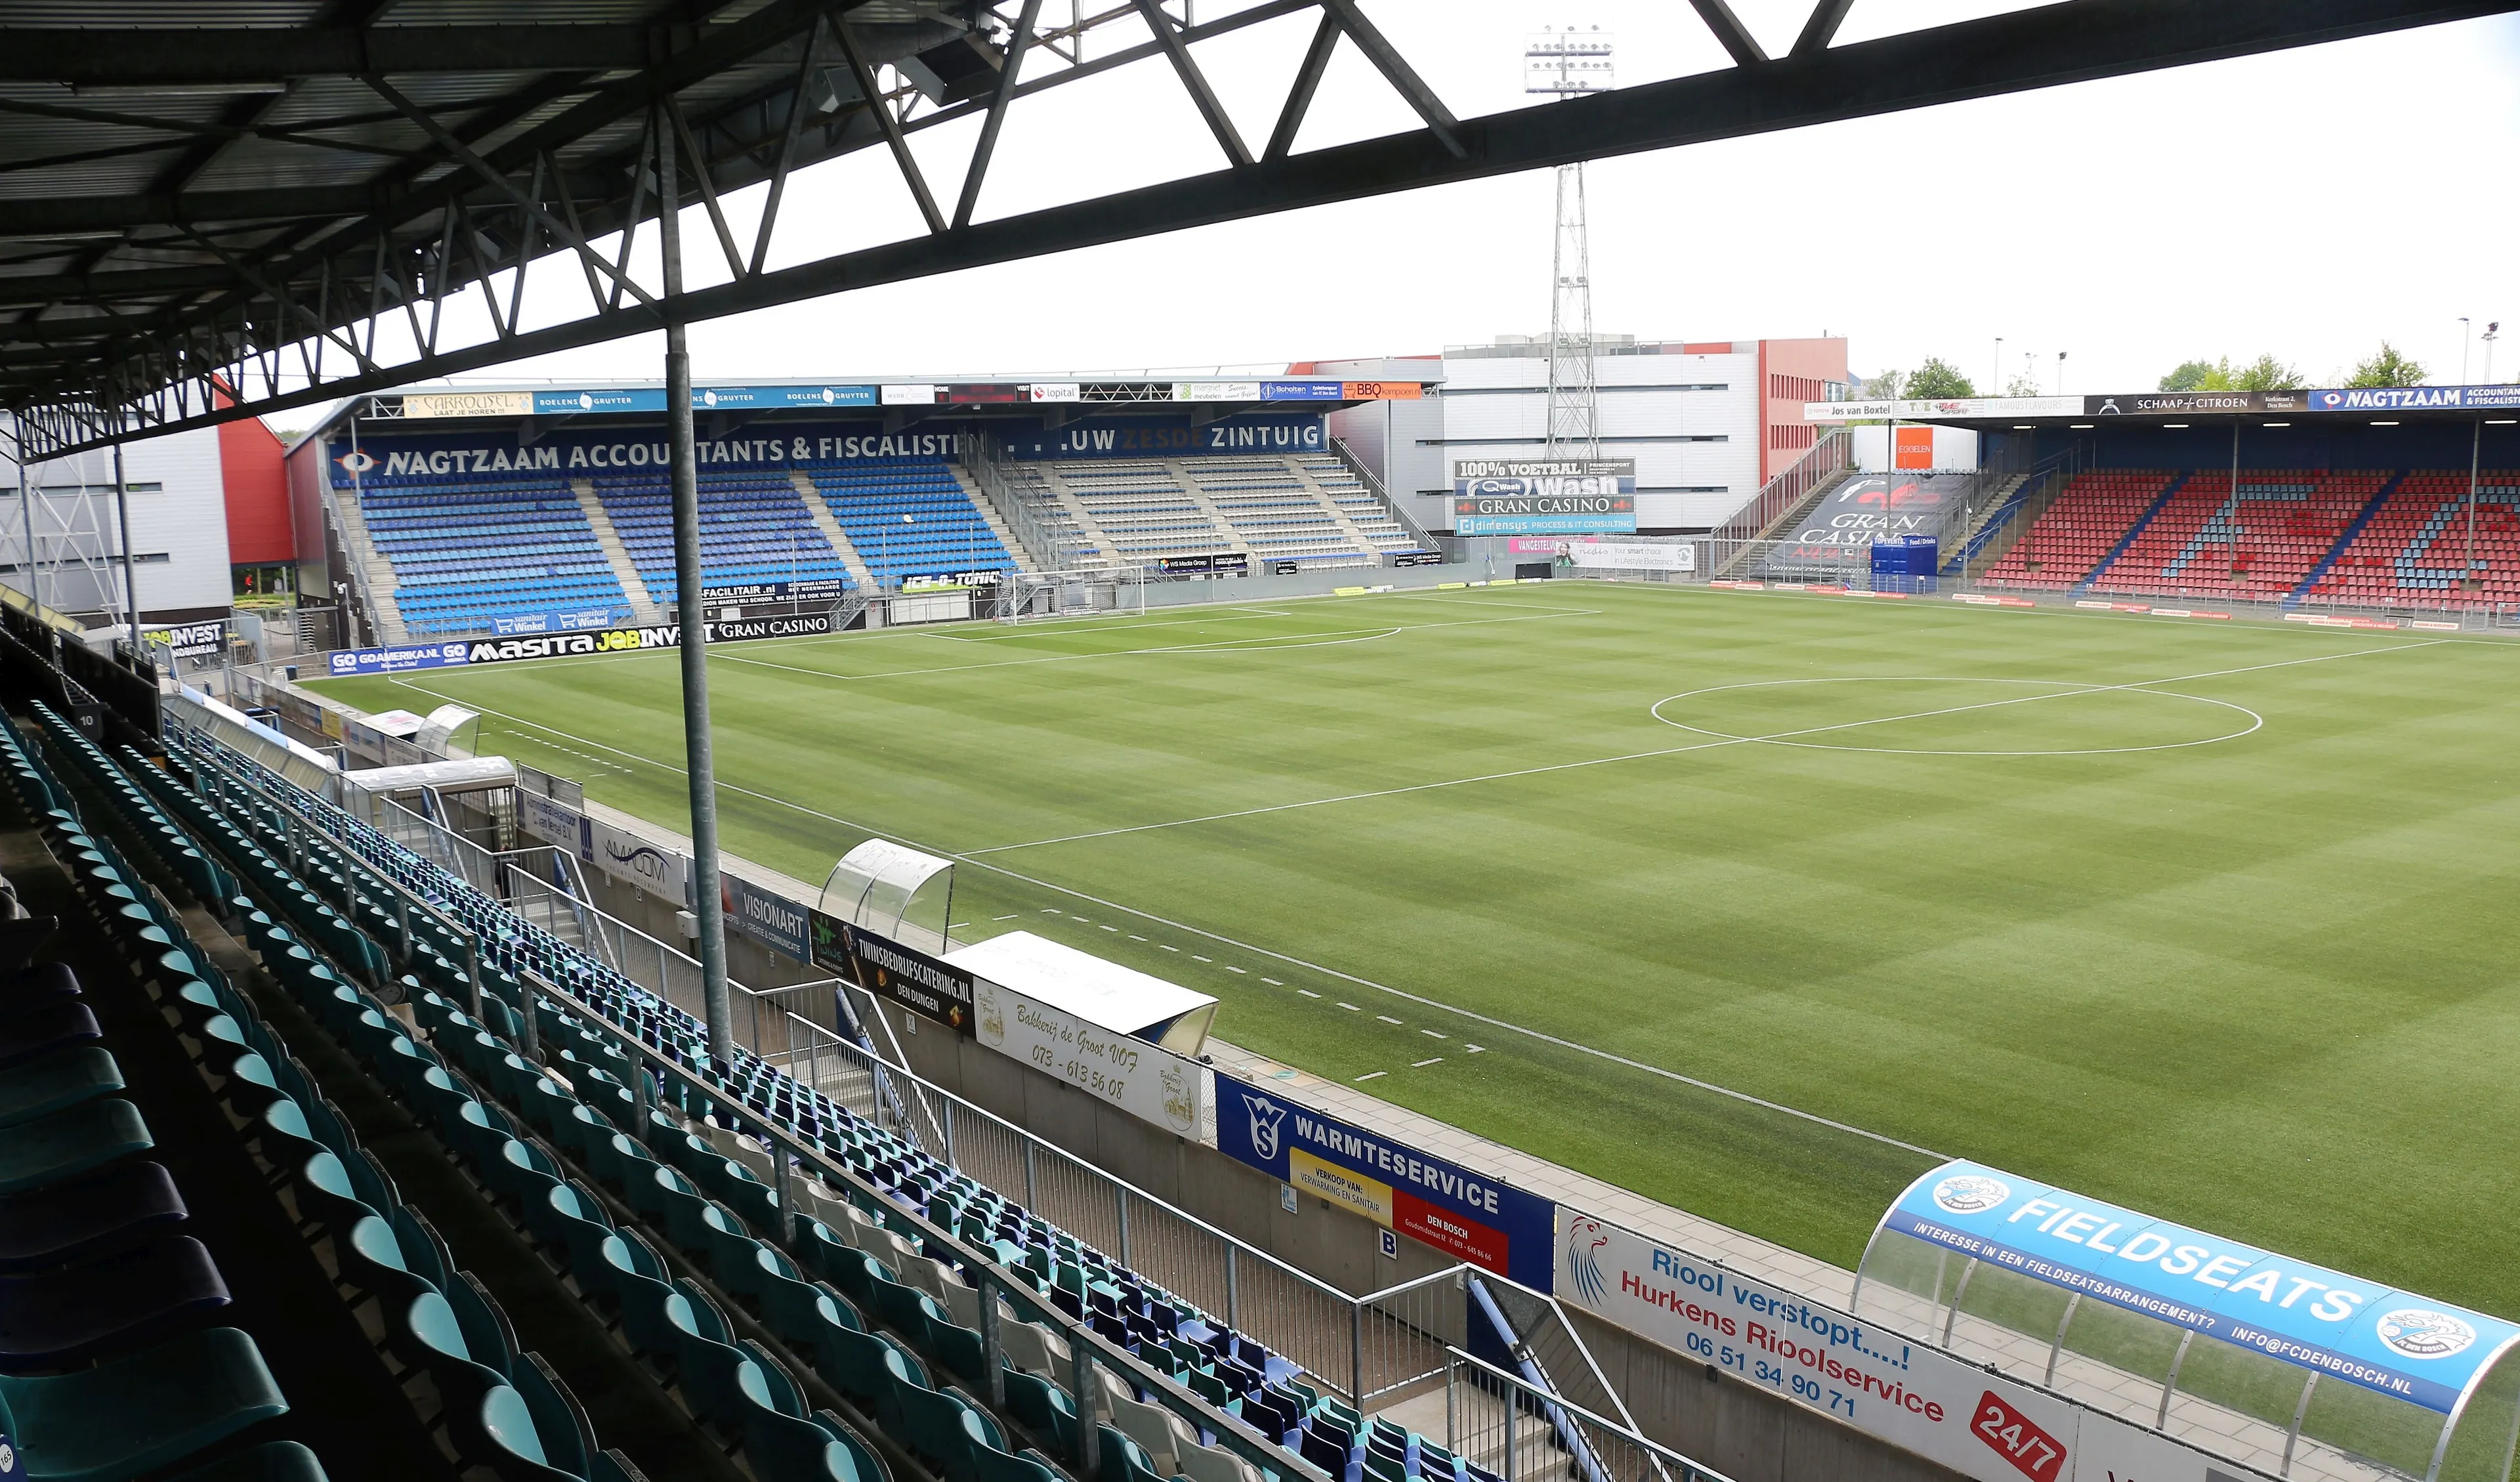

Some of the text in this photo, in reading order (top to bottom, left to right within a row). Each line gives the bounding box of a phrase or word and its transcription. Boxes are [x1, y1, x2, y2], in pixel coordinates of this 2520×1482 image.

[424, 394, 513, 410] CARROUSEL
[1047, 387, 1075, 398] lopital
[2344, 389, 2461, 408] NAGTZAAM
[1832, 406, 1844, 415] Jos
[1864, 404, 1891, 415] Boxtel
[1995, 400, 2025, 410] FAMOUS
[2025, 399, 2062, 410] FLAVOURS
[1122, 425, 1318, 449] ZESDE ZINTUIG
[383, 447, 560, 476] NAGTZAAM
[791, 436, 811, 460] &
[1460, 461, 1581, 476] 100% VOETBAL
[1535, 476, 1620, 495] Wash
[1479, 498, 1609, 513] GRAN CASINO
[1477, 520, 1527, 530] dimensys
[1831, 513, 1925, 530] GRAN
[1620, 557, 1643, 566] Lifestyle
[514, 613, 548, 624] sanitair
[577, 608, 610, 619] sanitair
[577, 616, 608, 627] Winkel
[514, 621, 546, 631] Winkel
[721, 618, 828, 638] GRAN CASINO
[359, 648, 440, 664] GOAMERIKA.NL
[443, 644, 466, 657] GO
[333, 654, 356, 667] GO
[80, 716, 93, 725] 10
[606, 839, 665, 883] AMACOM
[743, 892, 803, 939] VISIONART
[747, 922, 765, 937] CREATIE
[768, 932, 801, 954] COMMUNICATIE
[858, 939, 971, 1004] TWINSBEDRIJFSCATERING.NL
[897, 983, 939, 1013] DEN DUNGEN
[1017, 1004, 1139, 1073] Bakkerij de Groot VOF
[1032, 1045, 1124, 1099] 073 613 56 08
[1165, 1082, 1181, 1095] Groot
[1295, 1114, 1500, 1215] WARMTESERVICE
[1315, 1168, 1363, 1195] VERKOOP VAN:
[1300, 1172, 1380, 1214] VERWARMING EN SANITAIR
[1427, 1214, 1468, 1239] DEN BOSCH
[1383, 1231, 1396, 1255] B
[1405, 1219, 1440, 1239] Goudsmidstraat
[1454, 1240, 1463, 1249] 073
[1467, 1245, 1477, 1255] 645
[1477, 1250, 1484, 1259] 86
[1484, 1253, 1492, 1261] 66
[2007, 1198, 2364, 1323] FIELDSEATS
[1652, 1248, 1723, 1297] Riool
[1913, 1221, 2412, 1395] INTERESSE IN EEN FIELDSEATSARRANGEMENT? INFO@FCDENBOSCH.NL
[1622, 1270, 1944, 1423] Hurkens Rioolservice
[2422, 1344, 2446, 1352] BOSCH
[1687, 1331, 1855, 1418] 06 51 34 90 71
[1979, 1405, 2057, 1473] 24/7
[1, 1450, 12, 1466] 165
